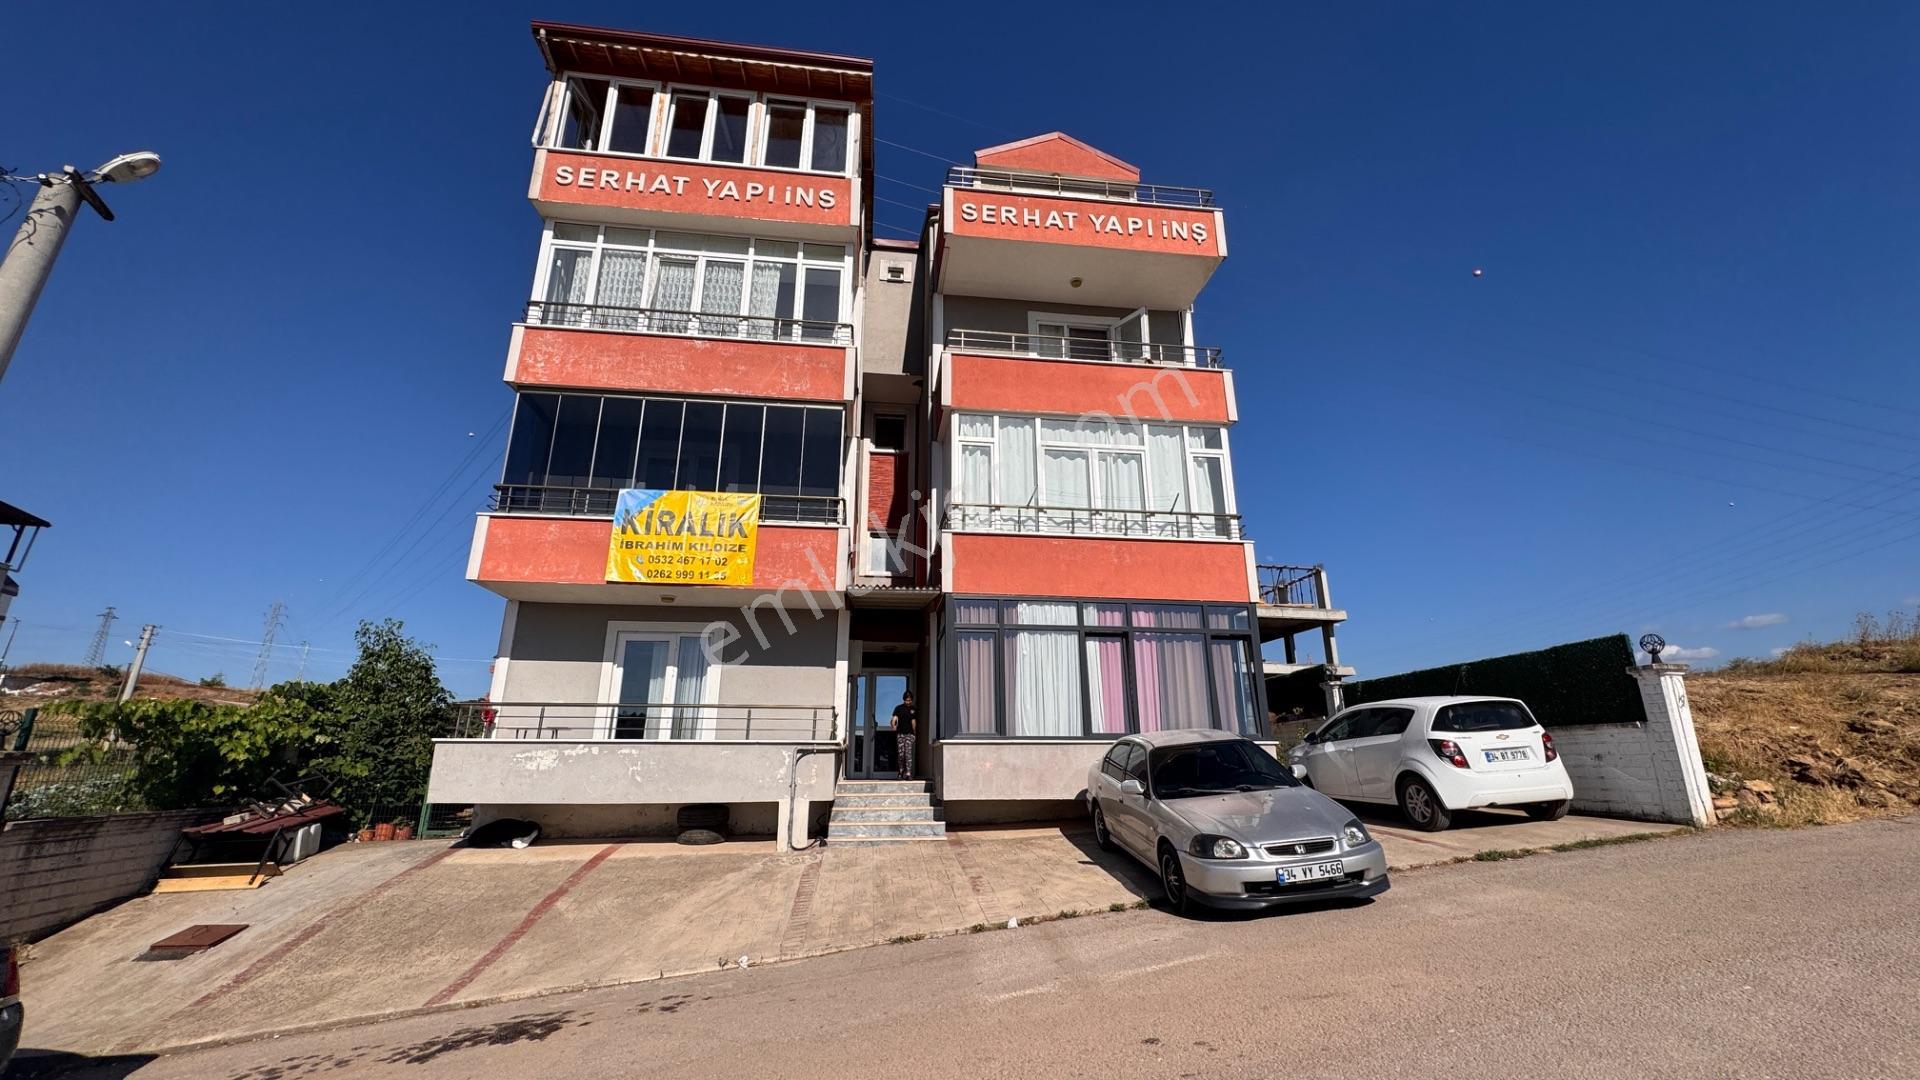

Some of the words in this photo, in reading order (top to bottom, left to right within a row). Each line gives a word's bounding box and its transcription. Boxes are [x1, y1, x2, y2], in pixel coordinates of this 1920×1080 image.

[555, 166, 690, 195] SERHAT
[702, 178, 775, 202] YAPI
[961, 203, 1078, 230] SERHAT
[1089, 214, 1153, 236] YAPI
[648, 555, 674, 565] 0532
[676, 556, 696, 566] 467
[700, 557, 712, 566] 17
[715, 557, 728, 567] 02
[646, 569, 673, 579] 0262
[675, 570, 695, 580] 999
[1284, 869, 1296, 880] 34
[1302, 867, 1313, 878] VY
[1319, 863, 1342, 876] 5466
